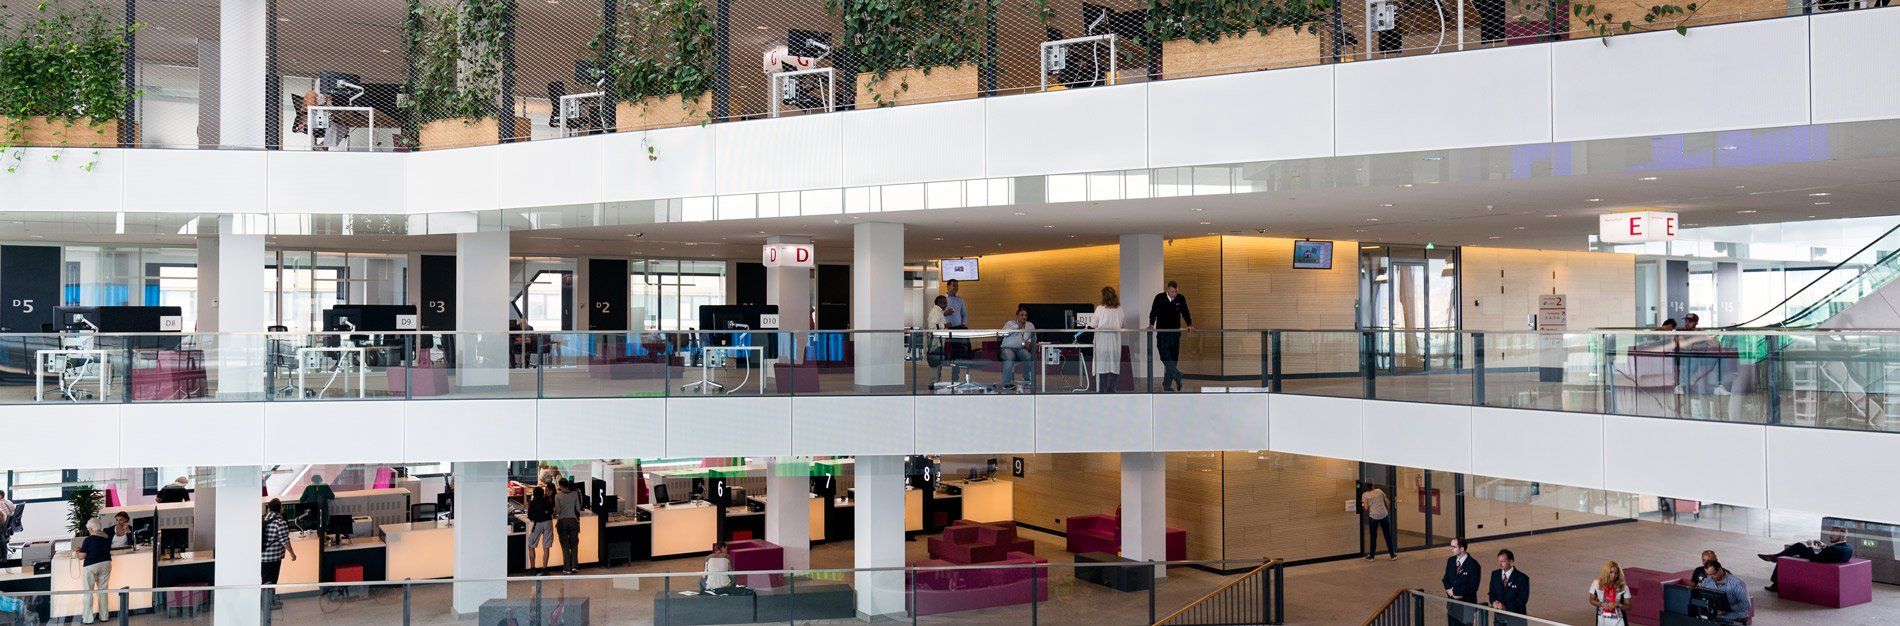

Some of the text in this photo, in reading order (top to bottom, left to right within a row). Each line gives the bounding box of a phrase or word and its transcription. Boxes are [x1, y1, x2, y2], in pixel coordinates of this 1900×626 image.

[1630, 217, 1642, 236] E
[1666, 218, 1674, 236] E
[770, 248, 776, 262] D
[796, 248, 808, 262] D
[12, 300, 34, 313] D5
[430, 300, 445, 313] D3
[596, 302, 610, 314] D2
[924, 466, 930, 482] 8
[1016, 460, 1022, 474] 9
[826, 472, 830, 488] 7
[718, 480, 724, 498] 6
[599, 488, 604, 506] 5
